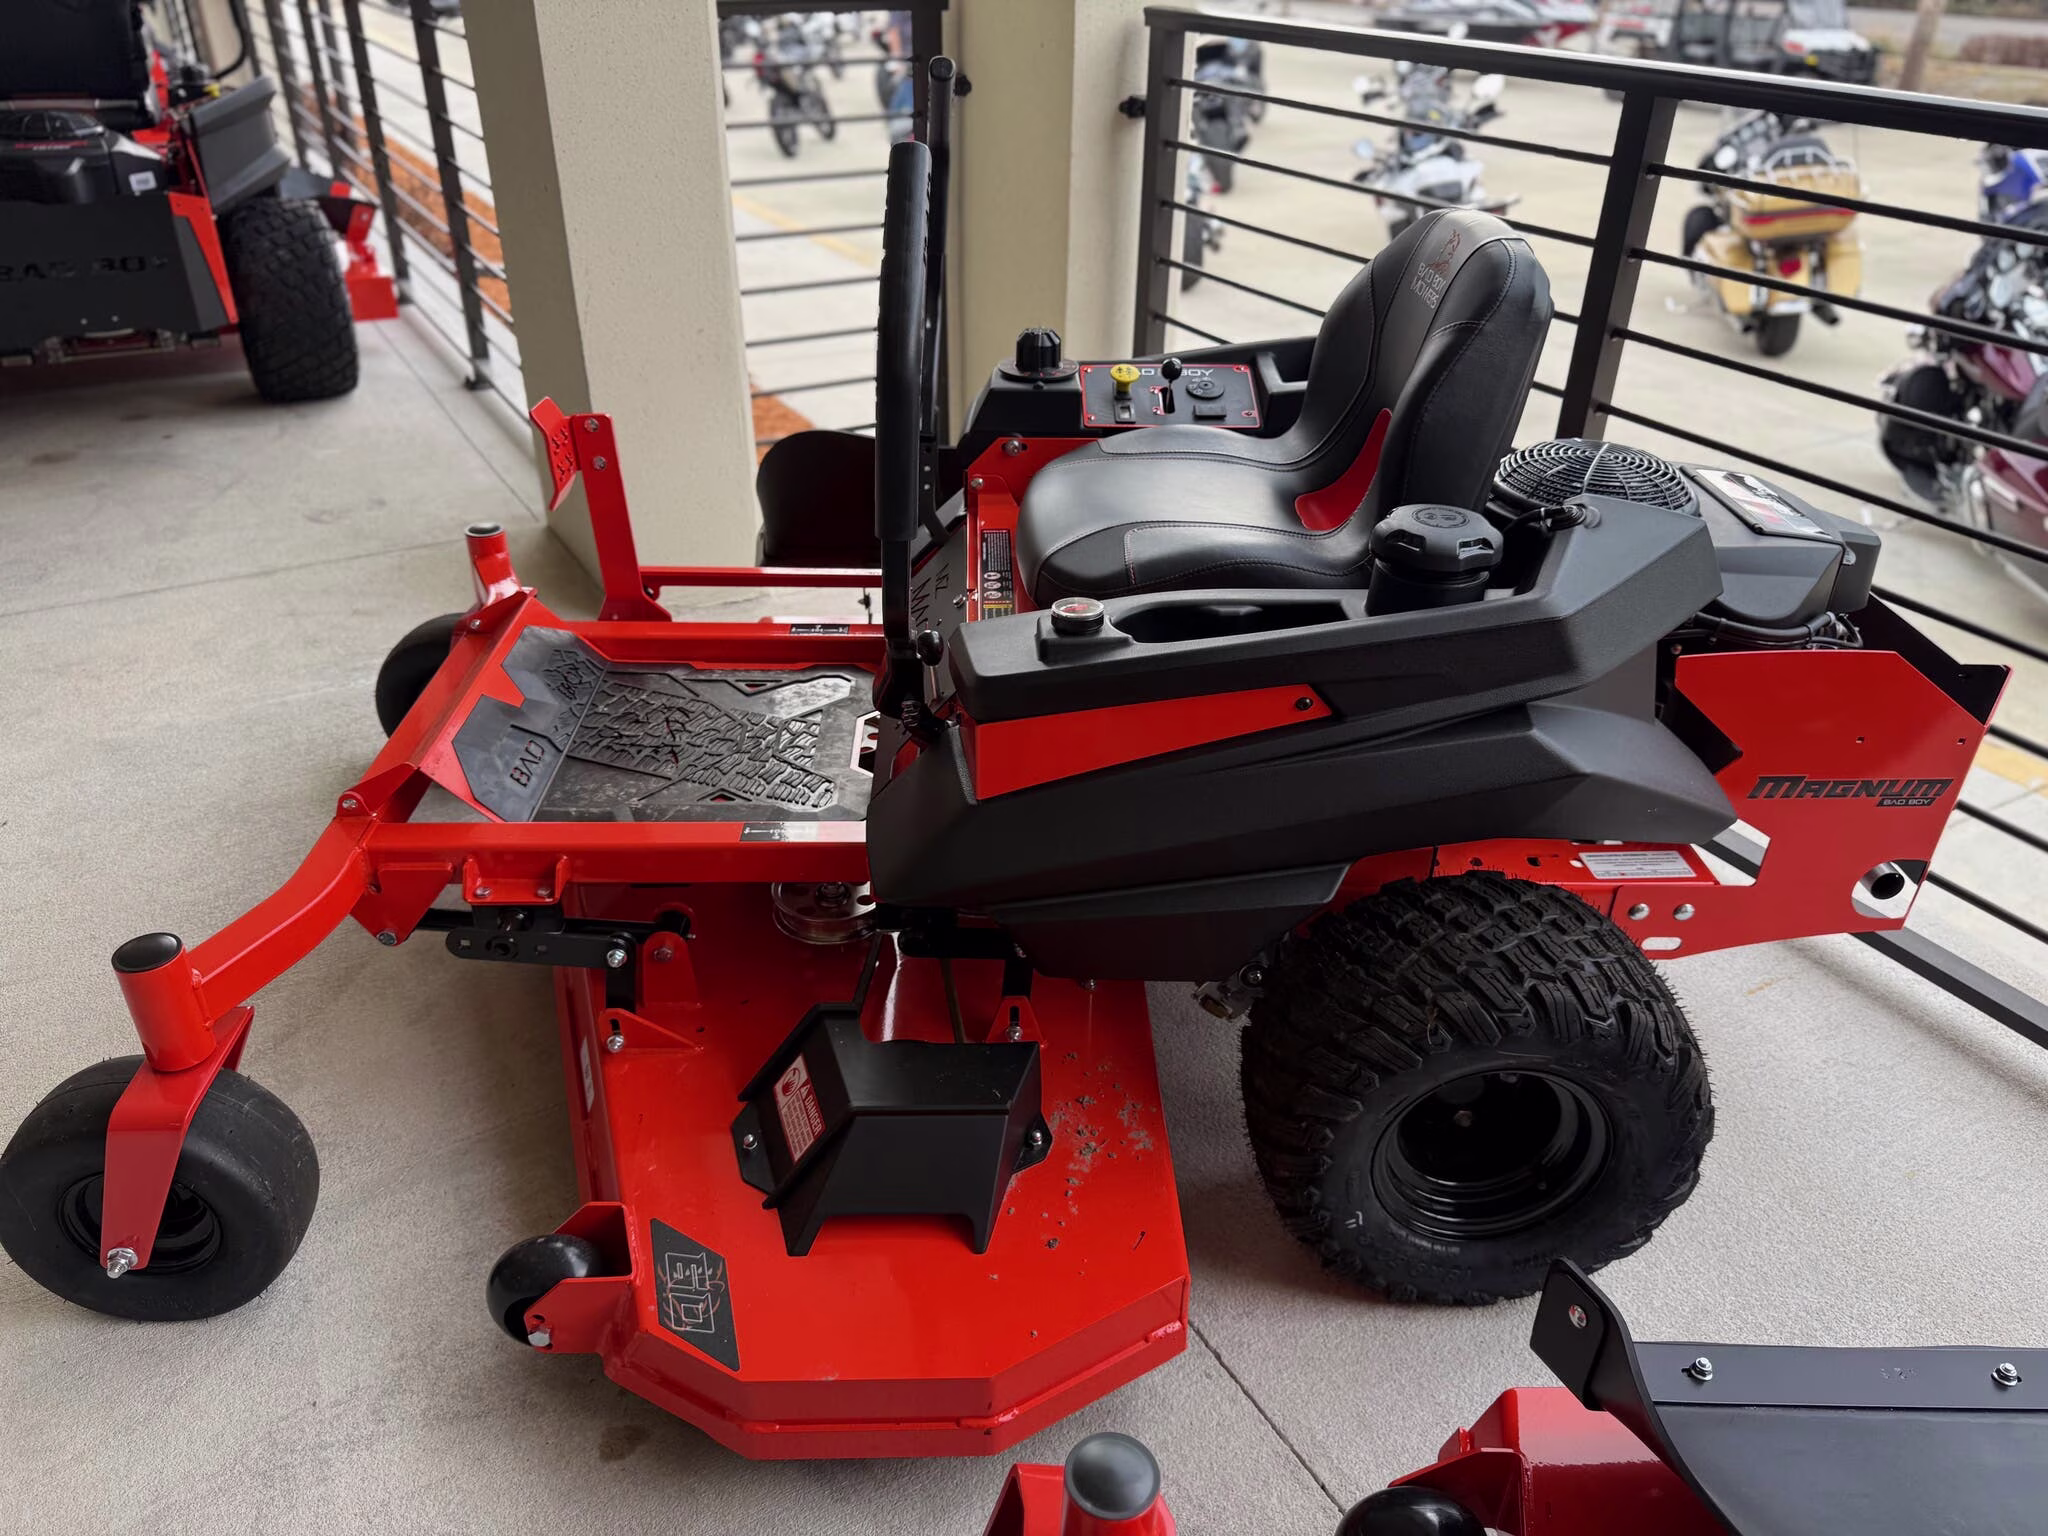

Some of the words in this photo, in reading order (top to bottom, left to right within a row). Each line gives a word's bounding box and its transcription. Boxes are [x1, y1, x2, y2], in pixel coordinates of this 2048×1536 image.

[1417, 262, 1435, 283] BAD
[1432, 274, 1447, 291] BOY
[1410, 276, 1440, 309] MOWERS
[1747, 775, 1954, 799] MAGNUM
[805, 1095, 822, 1137] DANGER
